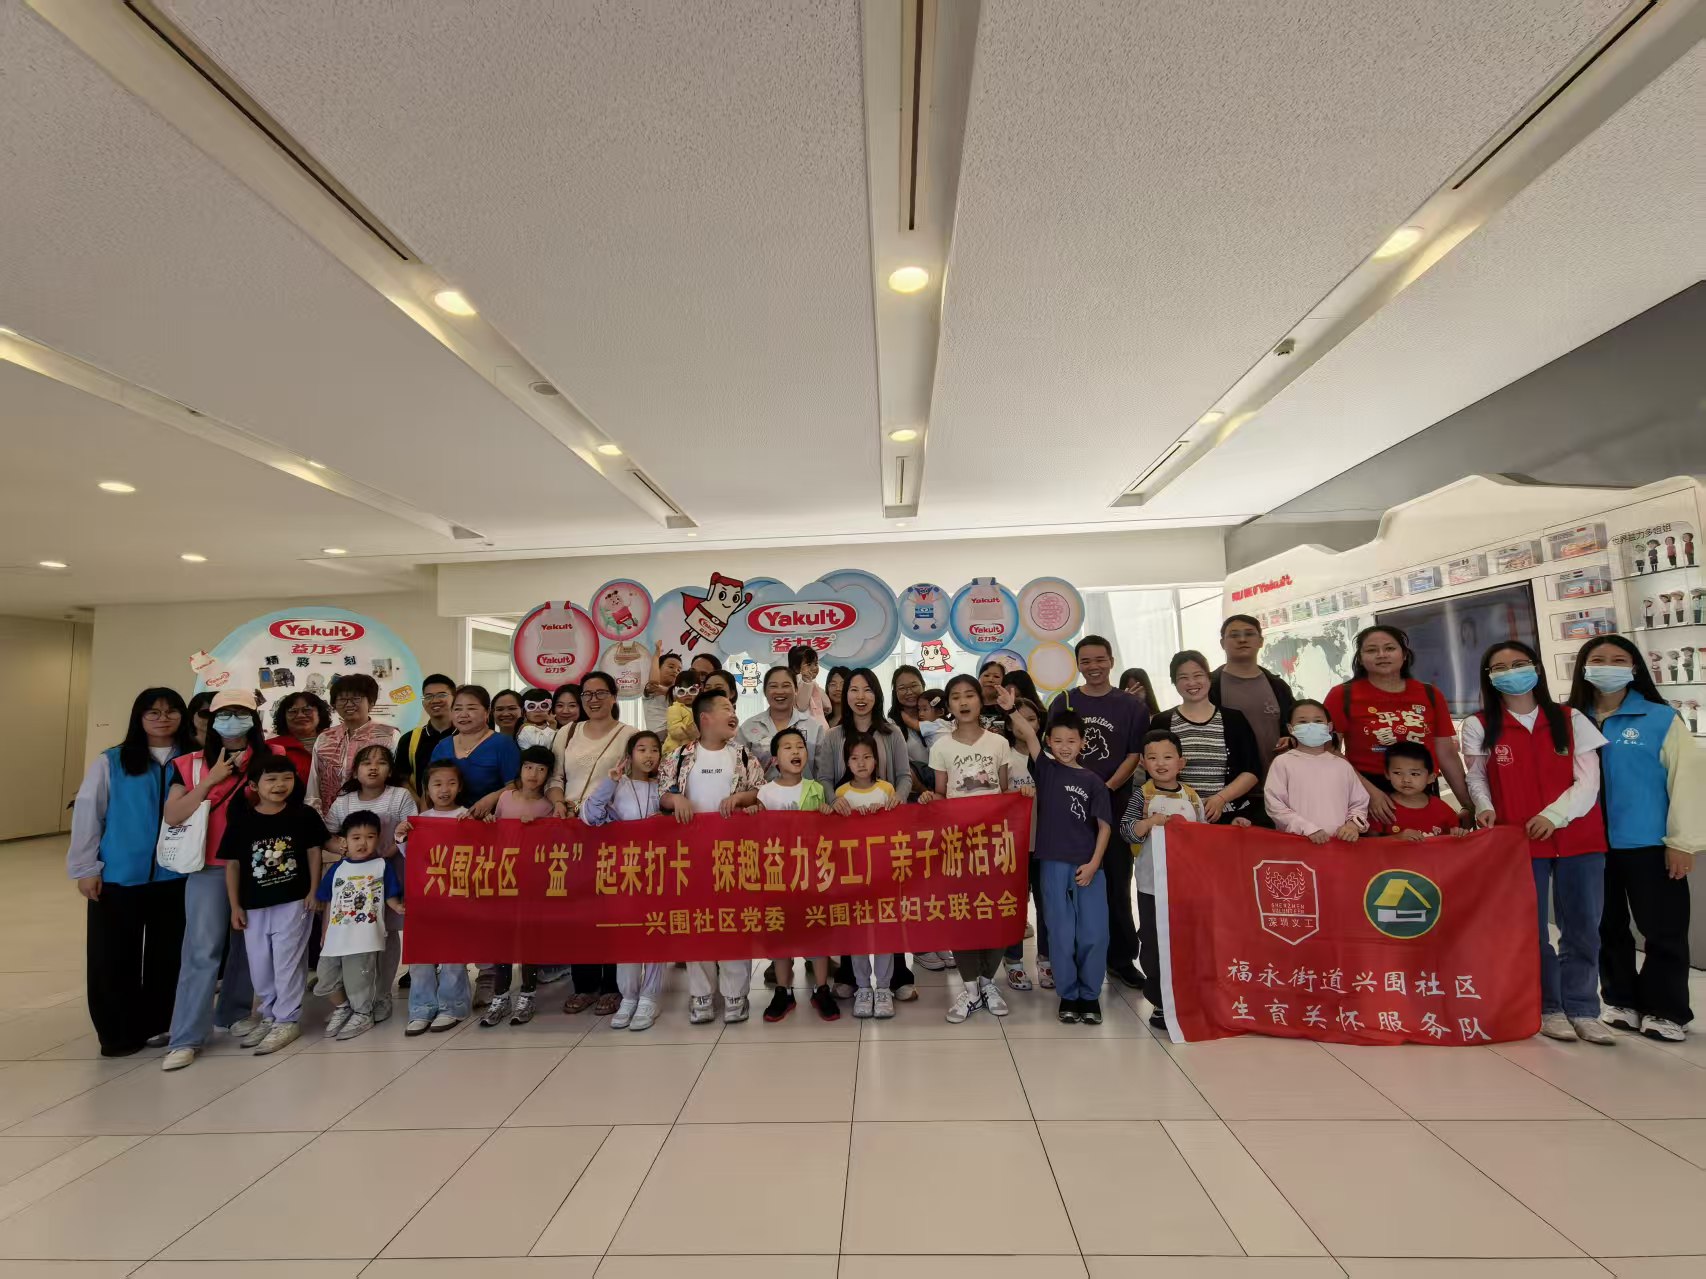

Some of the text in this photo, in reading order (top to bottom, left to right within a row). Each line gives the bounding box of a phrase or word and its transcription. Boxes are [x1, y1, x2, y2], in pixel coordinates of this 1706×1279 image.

[764, 609, 841, 627] Yakult
[286, 624, 352, 637] Yakult
[541, 623, 574, 631] Yakult
[973, 626, 1001, 634] Yakult
[291, 643, 343, 655] 益力多
[541, 656, 571, 664] Yakult
[805, 889, 1018, 927] 兴围社区妇女联合会
[1268, 917, 1314, 928] 深圳义工
[1228, 957, 1482, 1000] 福永街道兴围社区
[1231, 995, 1491, 1042] 生育关怀服务队
